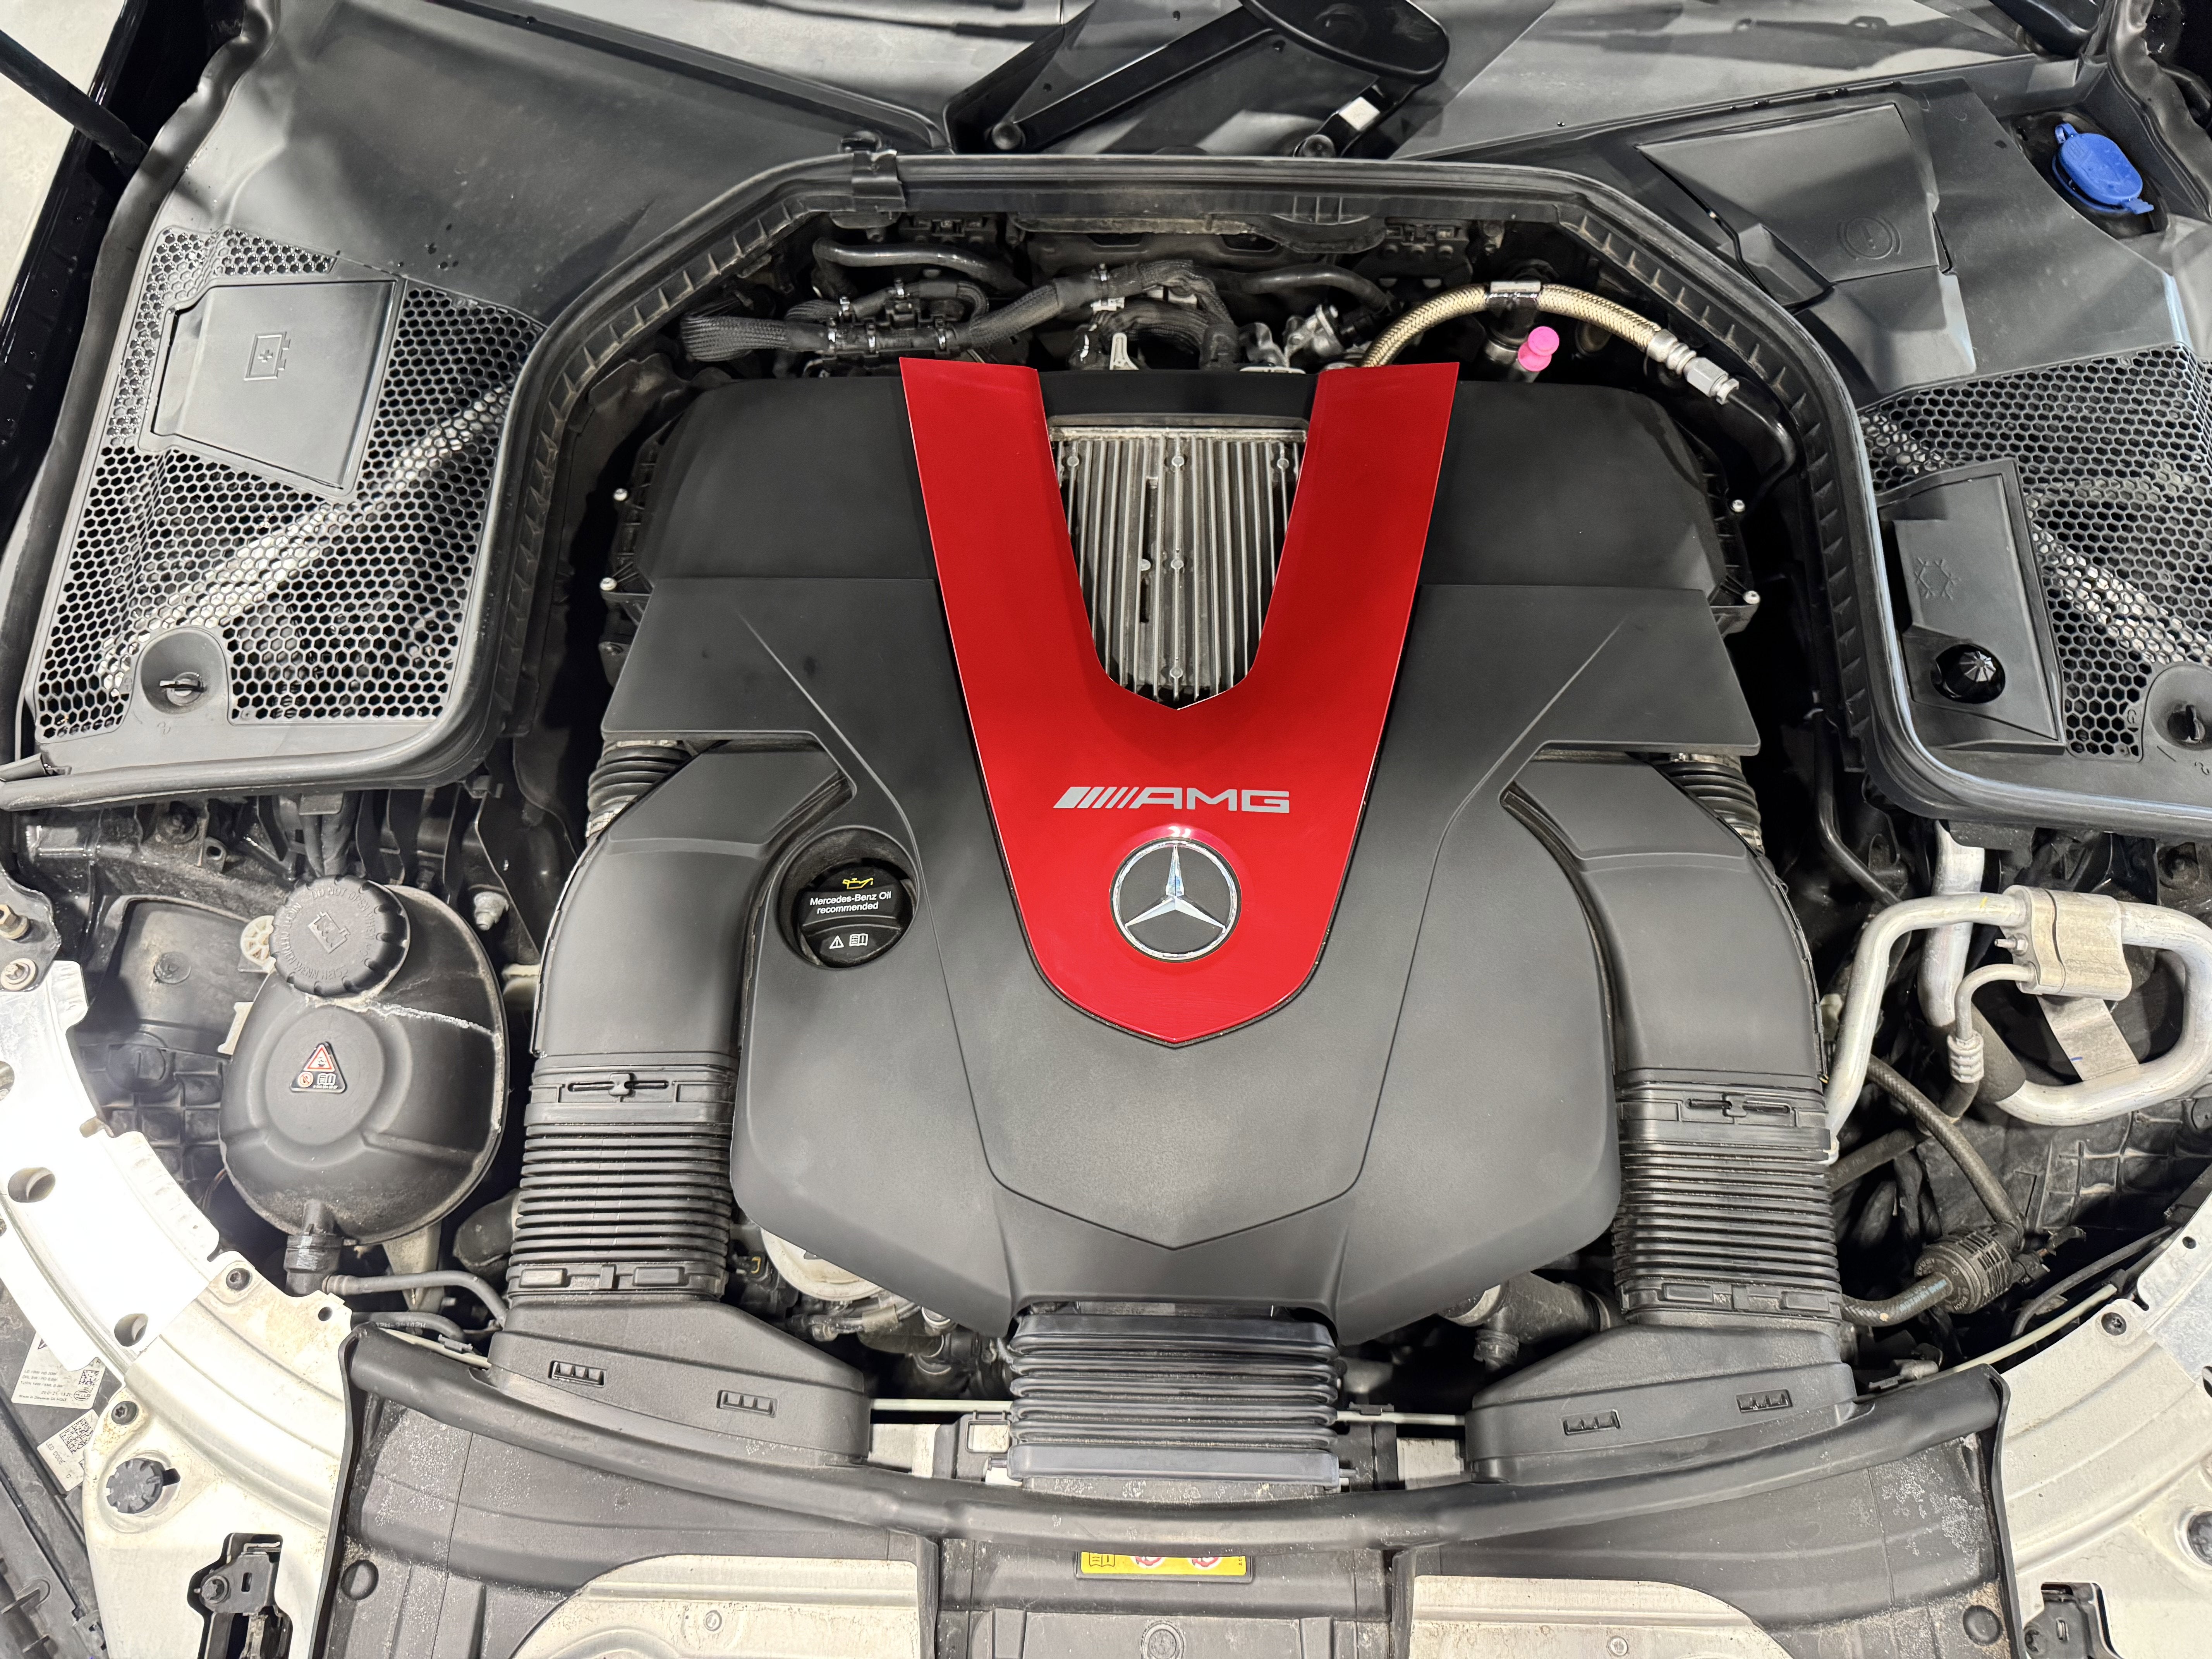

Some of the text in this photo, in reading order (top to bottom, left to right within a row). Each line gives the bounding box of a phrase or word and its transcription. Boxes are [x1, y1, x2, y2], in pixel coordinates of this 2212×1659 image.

[1129, 787, 1290, 813] AMG
[311, 888, 325, 900] DO
[328, 887, 347, 897] NOT
[349, 892, 370, 912] OPEN
[810, 891, 891, 906] Mercedes-Benz Oil
[817, 901, 879, 914] recommended
[46, 1441, 65, 1465] LED CODE
